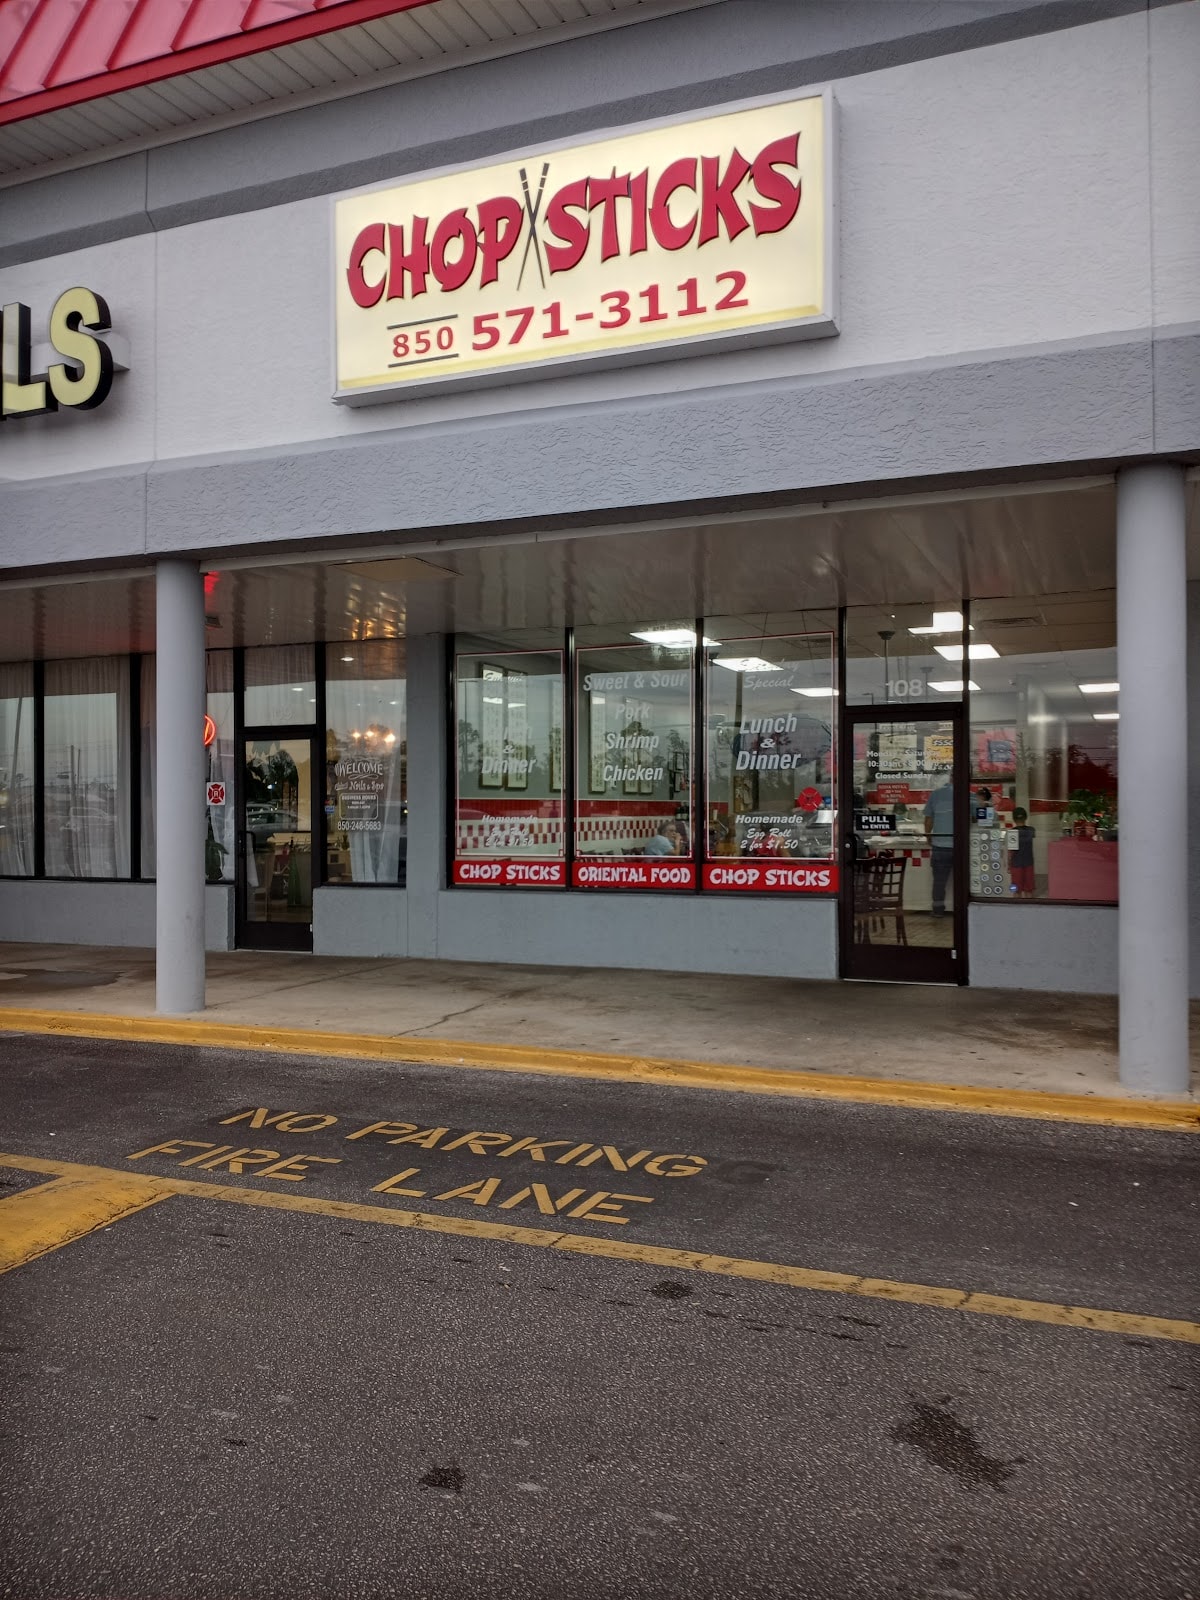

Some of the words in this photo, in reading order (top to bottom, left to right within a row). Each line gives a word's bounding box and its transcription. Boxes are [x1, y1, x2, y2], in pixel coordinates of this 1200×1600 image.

[347, 196, 524, 308] CHOP
[544, 131, 801, 276] STICKS
[392, 326, 454, 358] 850
[472, 271, 749, 351] 571-3112
[0, 286, 113, 418] LS
[583, 674, 630, 691] Sweet
[633, 673, 645, 688] &
[650, 672, 688, 688] Sour
[743, 675, 795, 691] Special
[887, 679, 923, 697] 108
[615, 701, 651, 720] Pork
[739, 713, 798, 734] Lunch
[503, 744, 516, 754] &
[605, 732, 660, 752] Shrimp
[760, 738, 776, 749] &
[736, 750, 801, 771] Dinner
[603, 764, 664, 782] Chicken
[903, 772, 932, 781] Sunday
[735, 814, 803, 824] Homemade
[747, 828, 766, 842] Egg
[769, 827, 791, 838] Roll
[740, 840, 748, 849] 2
[749, 840, 763, 851] for
[766, 839, 798, 850] $1.50
[459, 864, 502, 879] CHOP
[506, 864, 560, 881] STICKS
[578, 866, 647, 882] ORIENTAL
[650, 867, 691, 883] FOOD
[709, 868, 760, 885] CHOP
[765, 869, 830, 887] STICKS
[219, 1107, 338, 1133] NO
[345, 1121, 709, 1178] PARKING
[125, 1139, 343, 1182] FIRE
[370, 1167, 655, 1225] LANE
